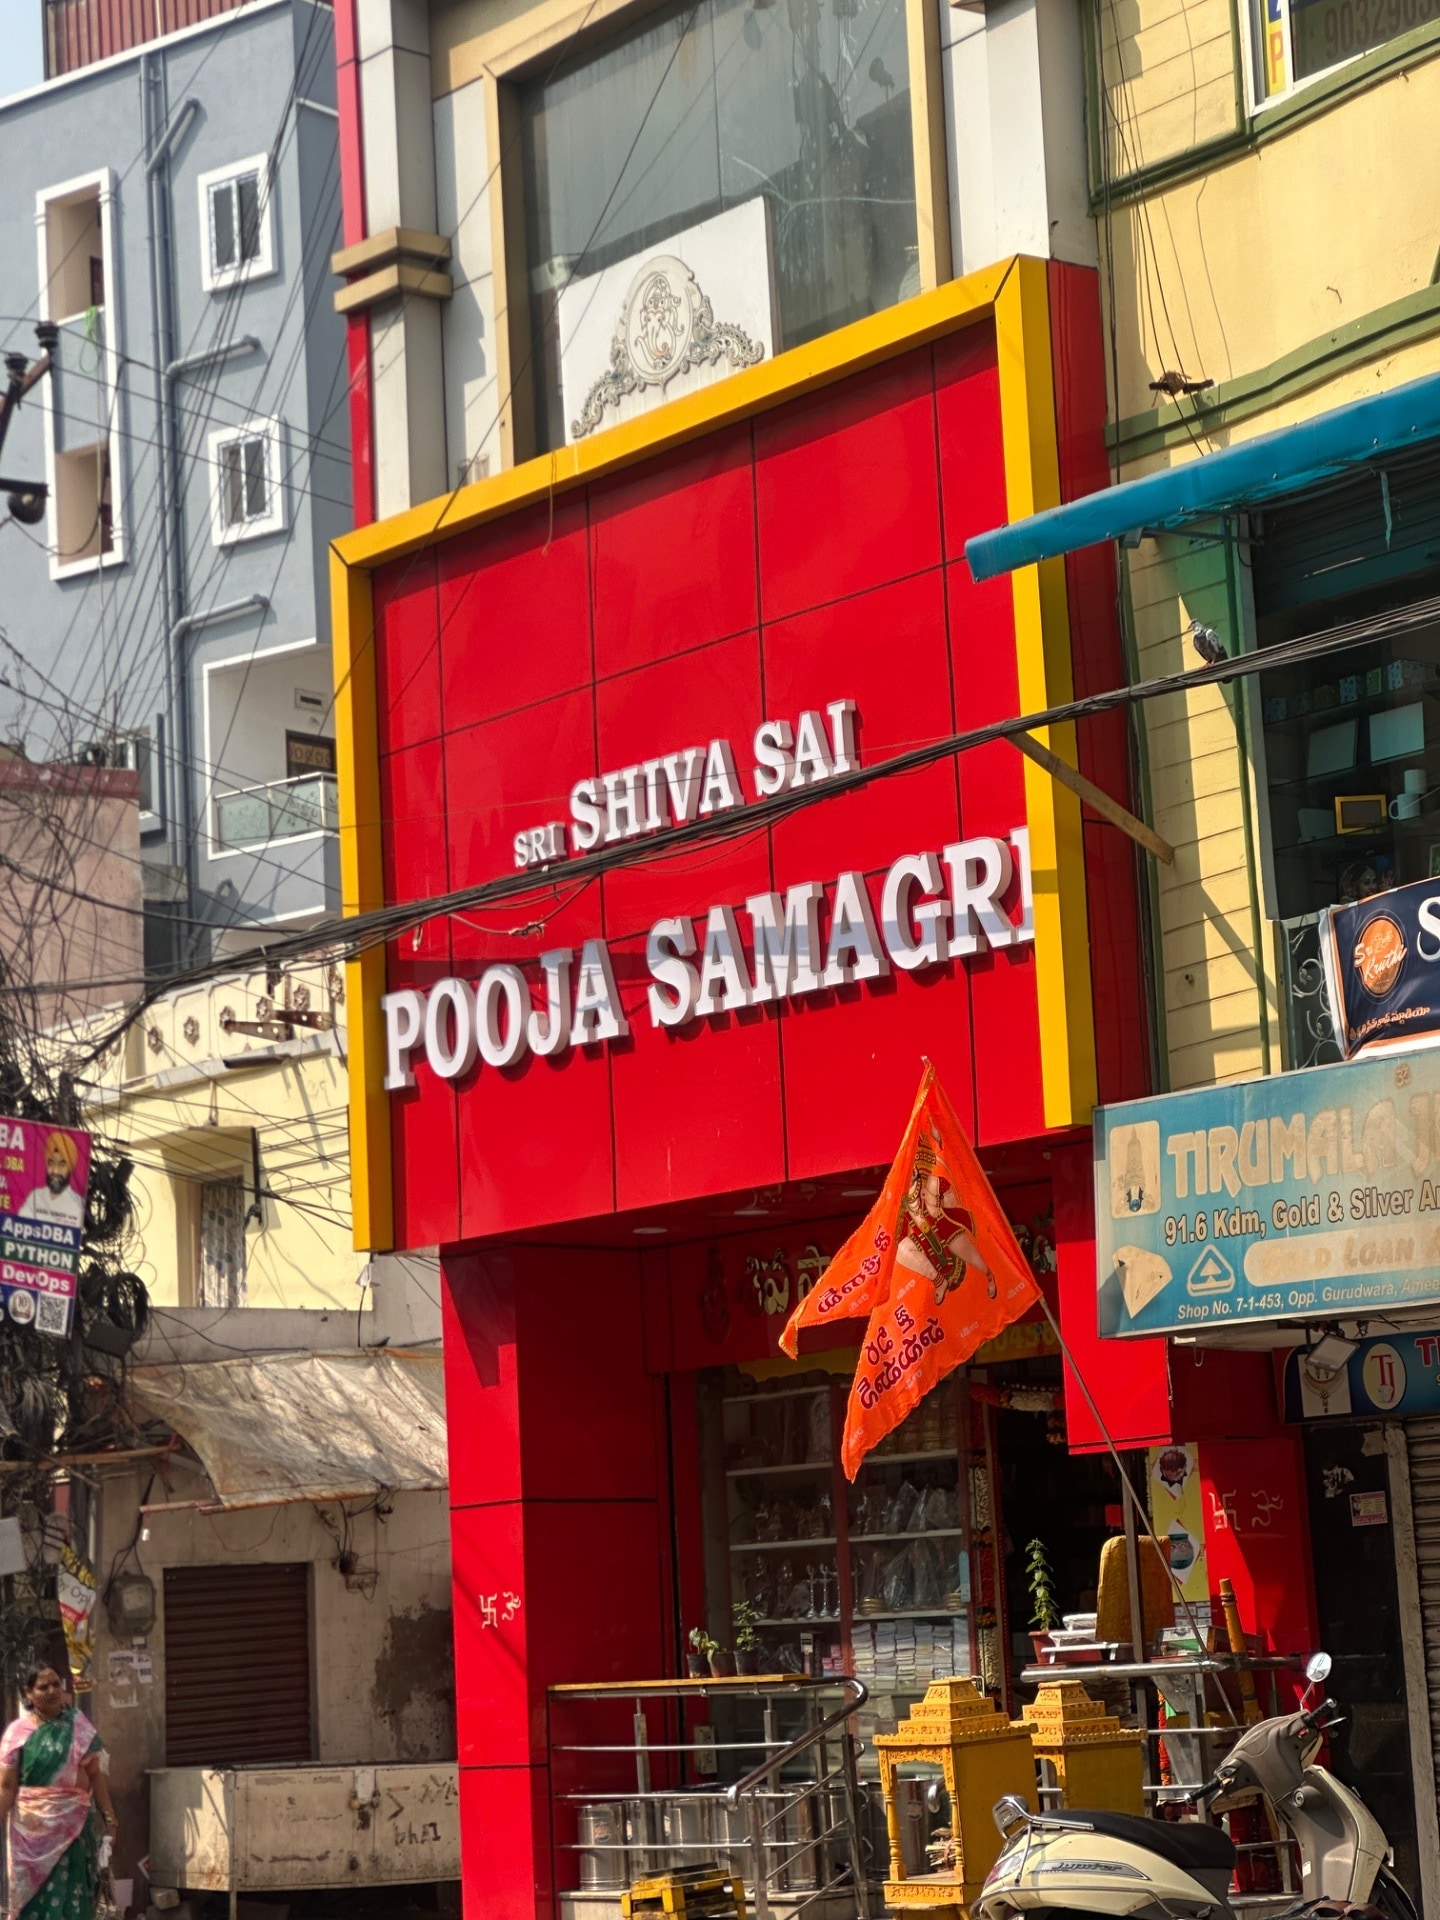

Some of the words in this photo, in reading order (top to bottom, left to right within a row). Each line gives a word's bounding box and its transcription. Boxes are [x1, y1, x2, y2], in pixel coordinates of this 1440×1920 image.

[514, 822, 567, 868] SRI
[570, 739, 744, 850] SHIVA
[754, 699, 860, 796] SAI
[382, 939, 629, 1091] POOJA
[647, 825, 1035, 1028] SAMAGRI
[1166, 1097, 1397, 1199] TIRUMALA
[2, 1217, 75, 1246] AppsDBA
[1164, 1212, 1208, 1246] 91.6
[1213, 1206, 1267, 1240] Kdm,
[1272, 1196, 1321, 1231] Gold
[1326, 1192, 1344, 1223] &
[1350, 1186, 1414, 1220] Silver
[2, 1264, 71, 1292] DevOps
[4, 1241, 74, 1269] PYTHON
[1177, 1303, 1209, 1320] Shop
[1212, 1299, 1233, 1315] No.
[1236, 1293, 1284, 1312] 7-1-453,
[1288, 1290, 1318, 1308] Opp.
[1322, 1283, 1398, 1301] Gurudwara,
